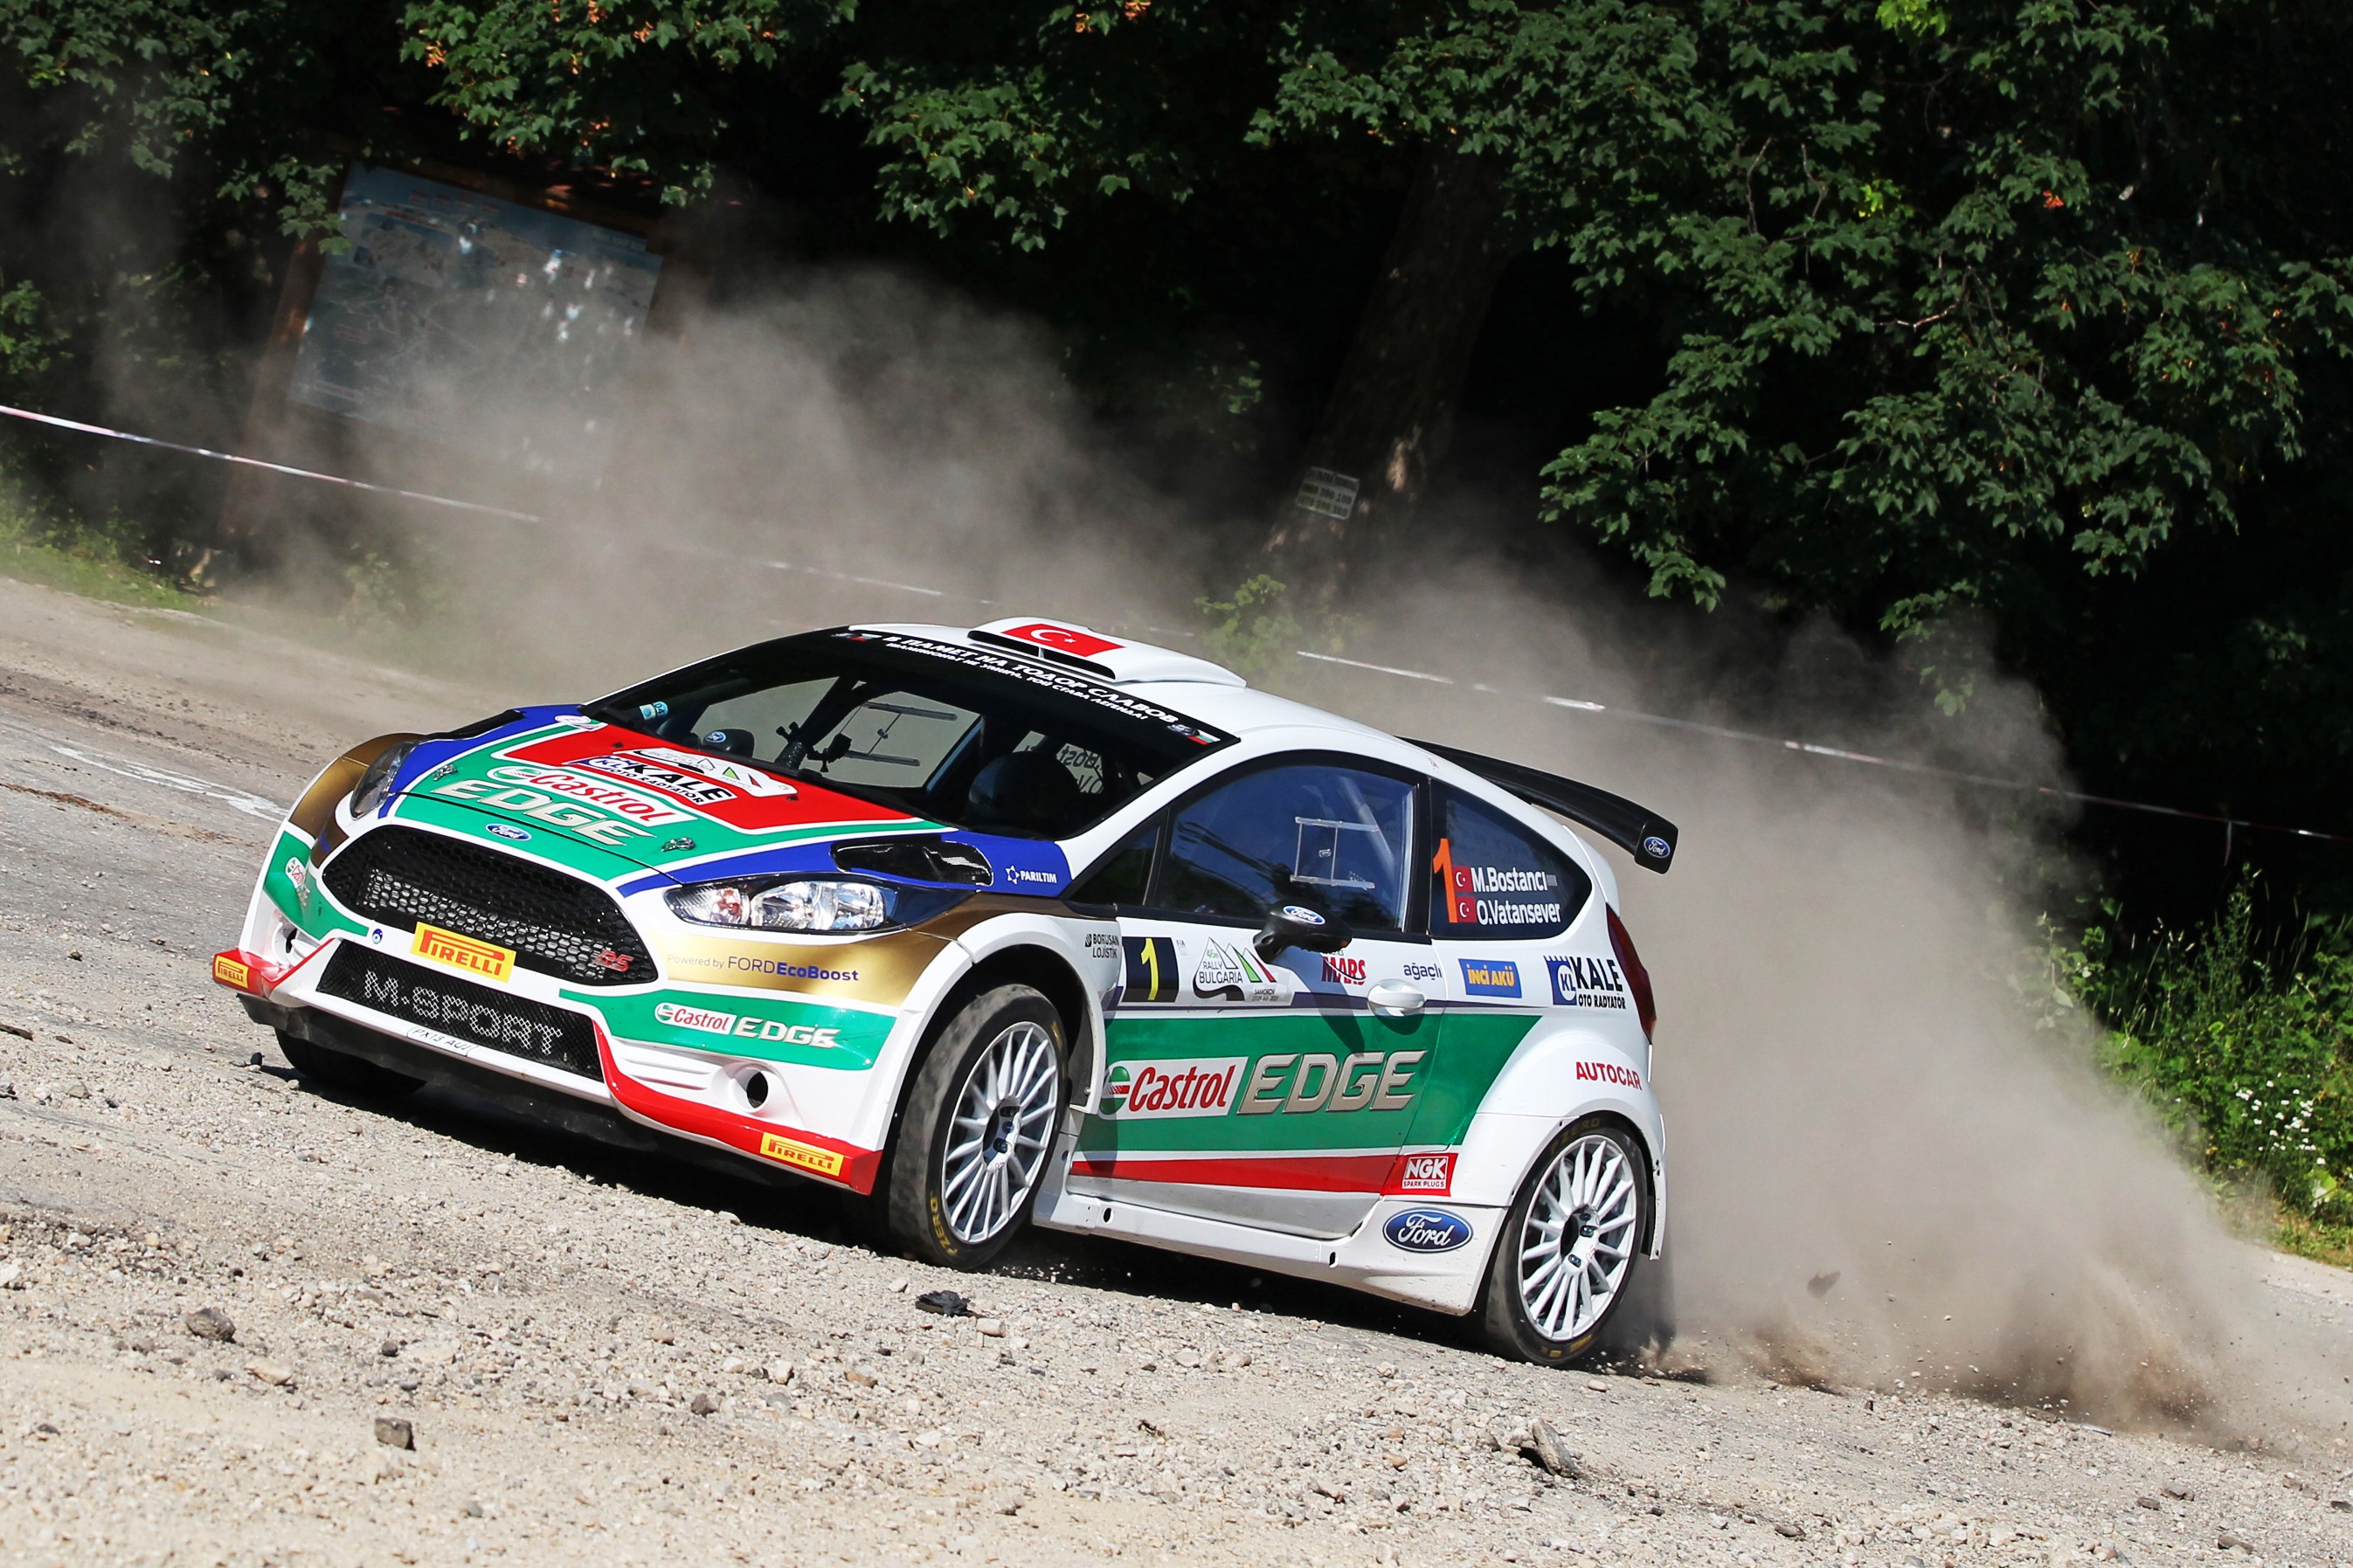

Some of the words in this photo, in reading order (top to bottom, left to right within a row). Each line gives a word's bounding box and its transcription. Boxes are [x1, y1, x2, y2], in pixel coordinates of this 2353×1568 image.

[903, 639, 979, 658] ПАМЕТ
[973, 653, 1008, 667] НА
[1012, 664, 1089, 689] ТОДОР
[1088, 688, 1180, 723] СЛАВОВ
[529, 774, 678, 822] Castrol
[623, 763, 732, 801] KALE
[430, 778, 657, 846] EDGE
[1020, 870, 1057, 884] PARILTIM
[1432, 838, 1458, 923] 1
[1476, 899, 1561, 926] O.Vatansever
[419, 929, 506, 977] PIRELLI
[1092, 933, 1119, 946] BORUSAN
[218, 960, 244, 983] PIRELLI
[667, 953, 711, 967] Powered
[712, 957, 724, 971] by
[1140, 937, 1159, 1001] 1
[1199, 971, 1243, 984] BULGARIA
[1202, 961, 1223, 971] RALLY
[1321, 956, 1367, 985] MARS
[1491, 964, 1515, 987] AKÜ
[1569, 956, 1623, 992] KALE
[1578, 994, 1592, 1007] OTO
[673, 1008, 730, 1032] Castrol
[732, 1016, 841, 1050] EDGE
[1128, 1063, 1236, 1113] Castrol
[1235, 1049, 1429, 1116] EDGE
[1575, 1060, 1643, 1091] AUTOCAR
[767, 1138, 834, 1171] PIRELLI
[1403, 1157, 1447, 1180] NGK
[1397, 1212, 1456, 1247] Ford
